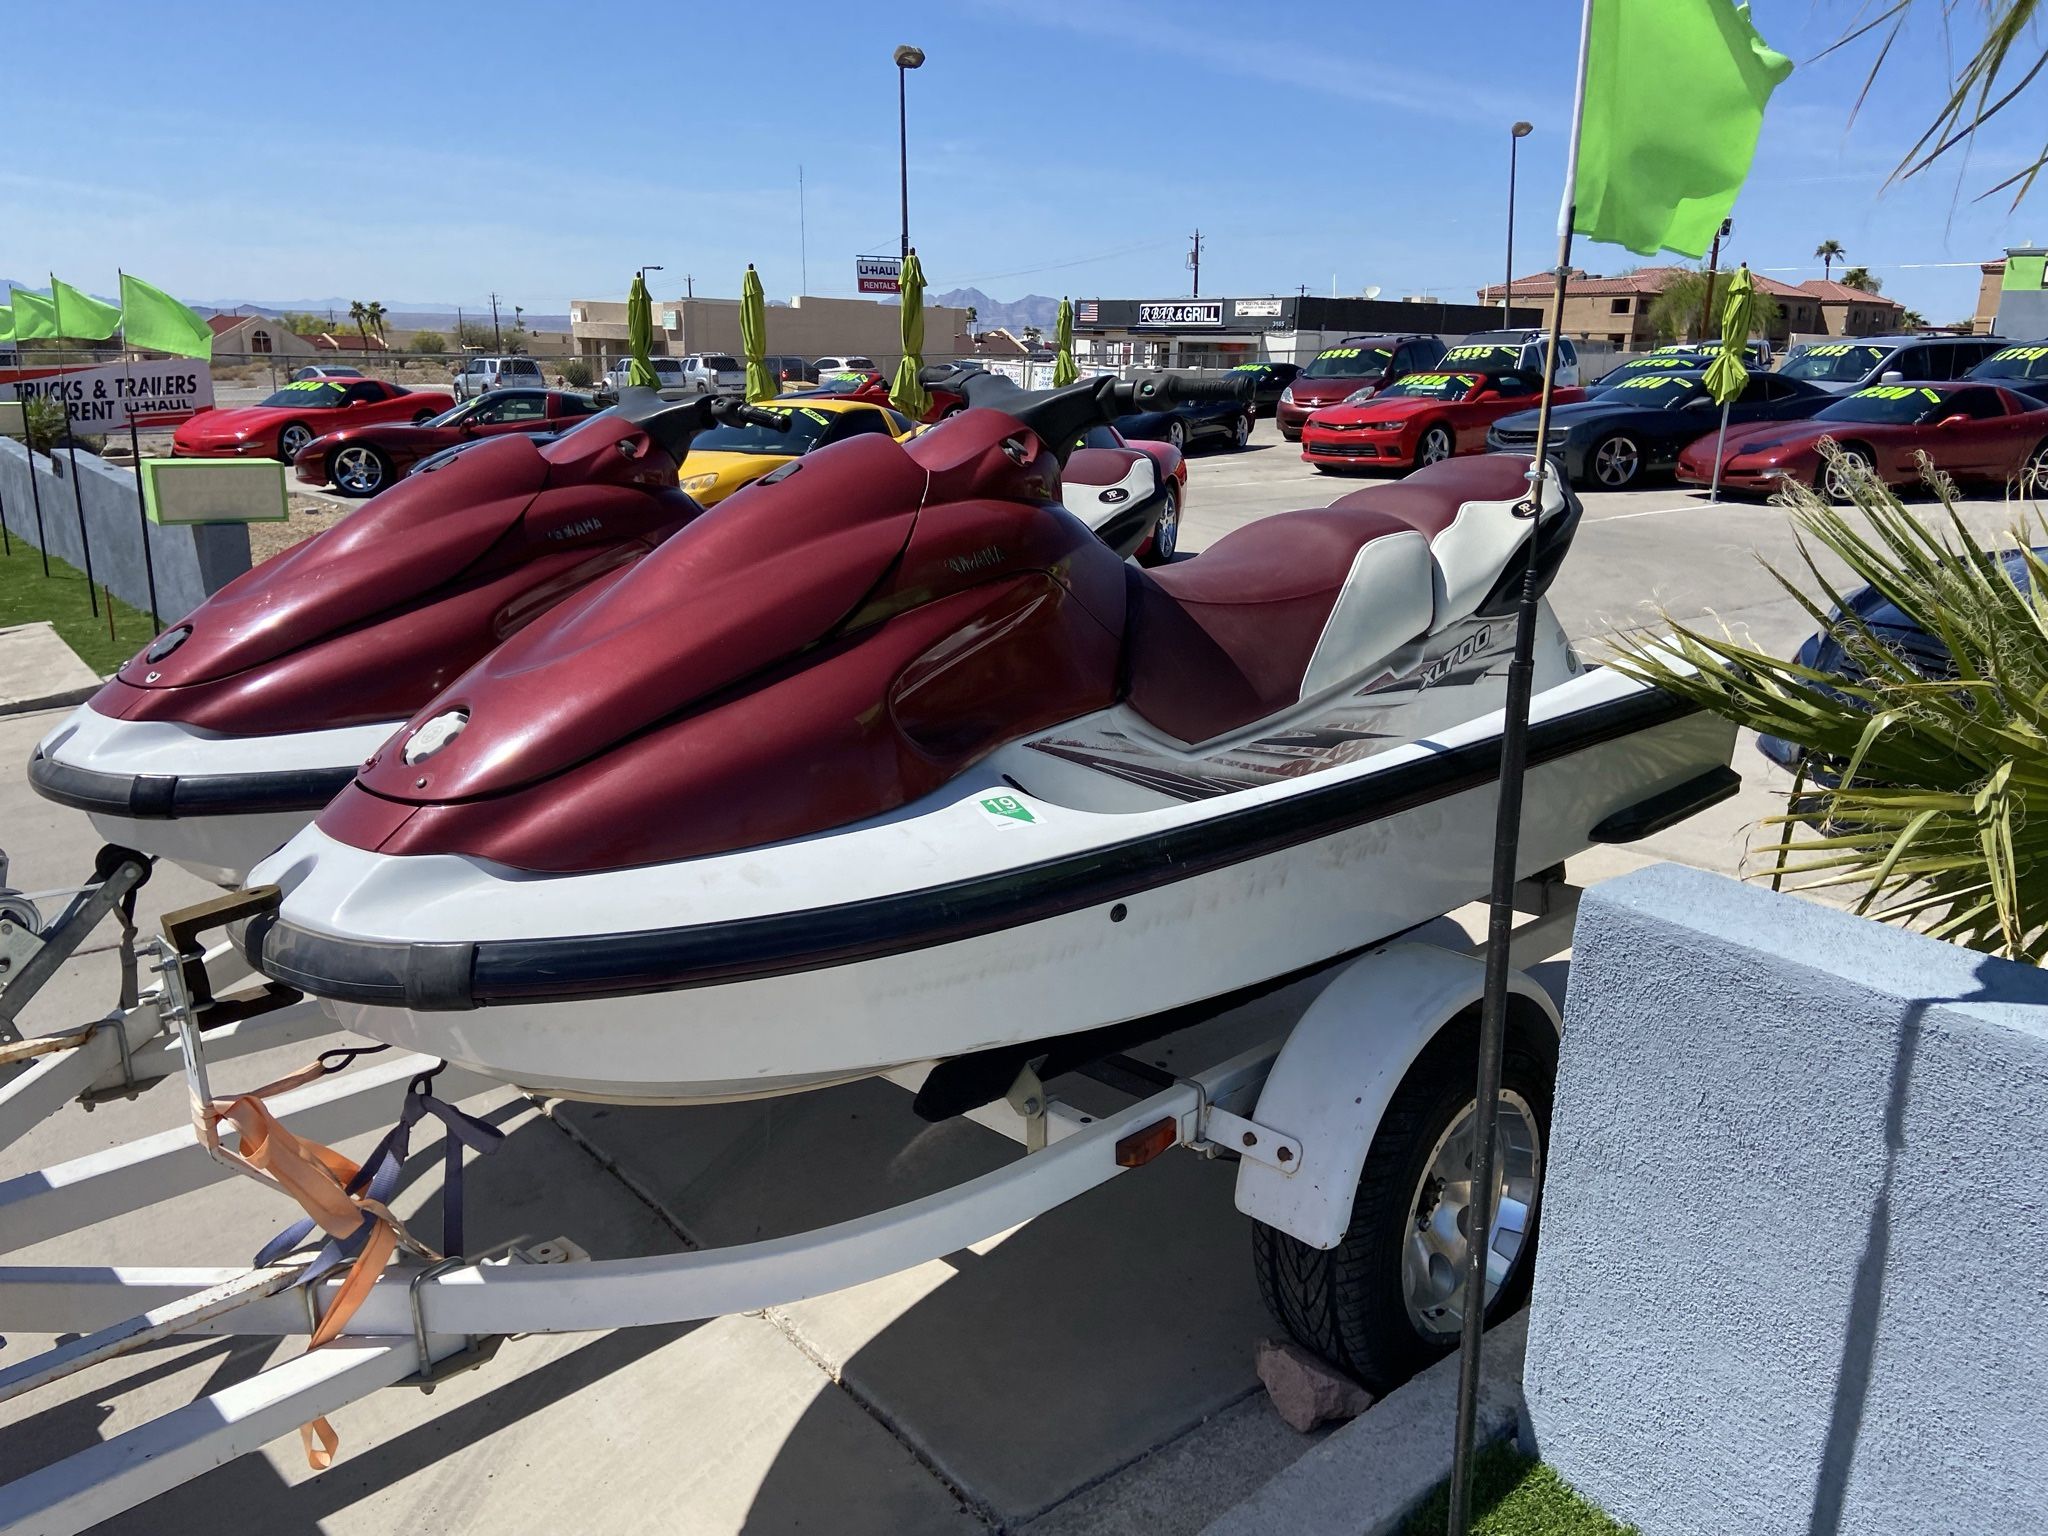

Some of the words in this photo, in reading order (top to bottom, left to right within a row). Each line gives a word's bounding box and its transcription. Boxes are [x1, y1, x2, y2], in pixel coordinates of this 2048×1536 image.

[860, 265, 899, 276] U-HAUL
[863, 281, 897, 290] RENTALS
[1183, 306, 1218, 322] GRILL
[13, 379, 83, 402] TRUCKS
[92, 379, 108, 399] &
[115, 374, 197, 398] TRAILERS
[69, 400, 115, 422] RENT
[124, 398, 192, 413] U-HAUL
[1418, 624, 1491, 693] XL700
[986, 797, 1017, 812] 19
